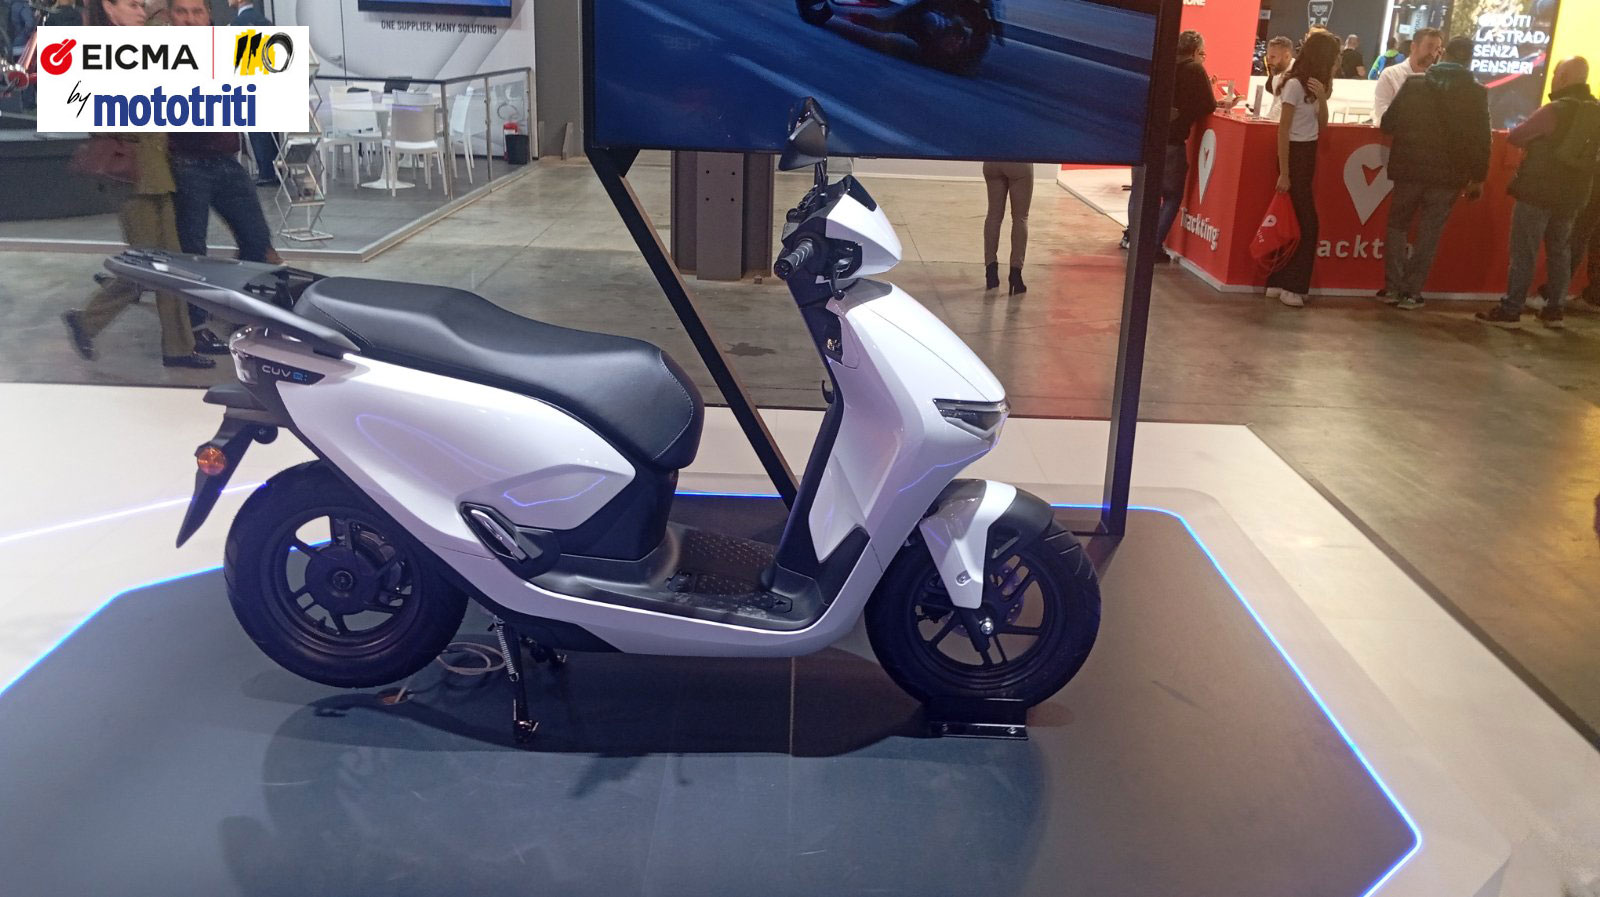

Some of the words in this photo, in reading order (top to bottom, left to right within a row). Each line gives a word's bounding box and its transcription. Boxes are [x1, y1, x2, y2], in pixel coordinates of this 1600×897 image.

[381, 20, 395, 30] ONE
[397, 21, 434, 32] SUPPLIER,
[436, 22, 456, 33] MANY
[458, 24, 498, 35] SOLUTIONS
[1475, 29, 1494, 42] LA
[1473, 45, 1520, 58] SENZA
[1470, 60, 1534, 74] PENSIERI
[261, 365, 291, 377] CUV
